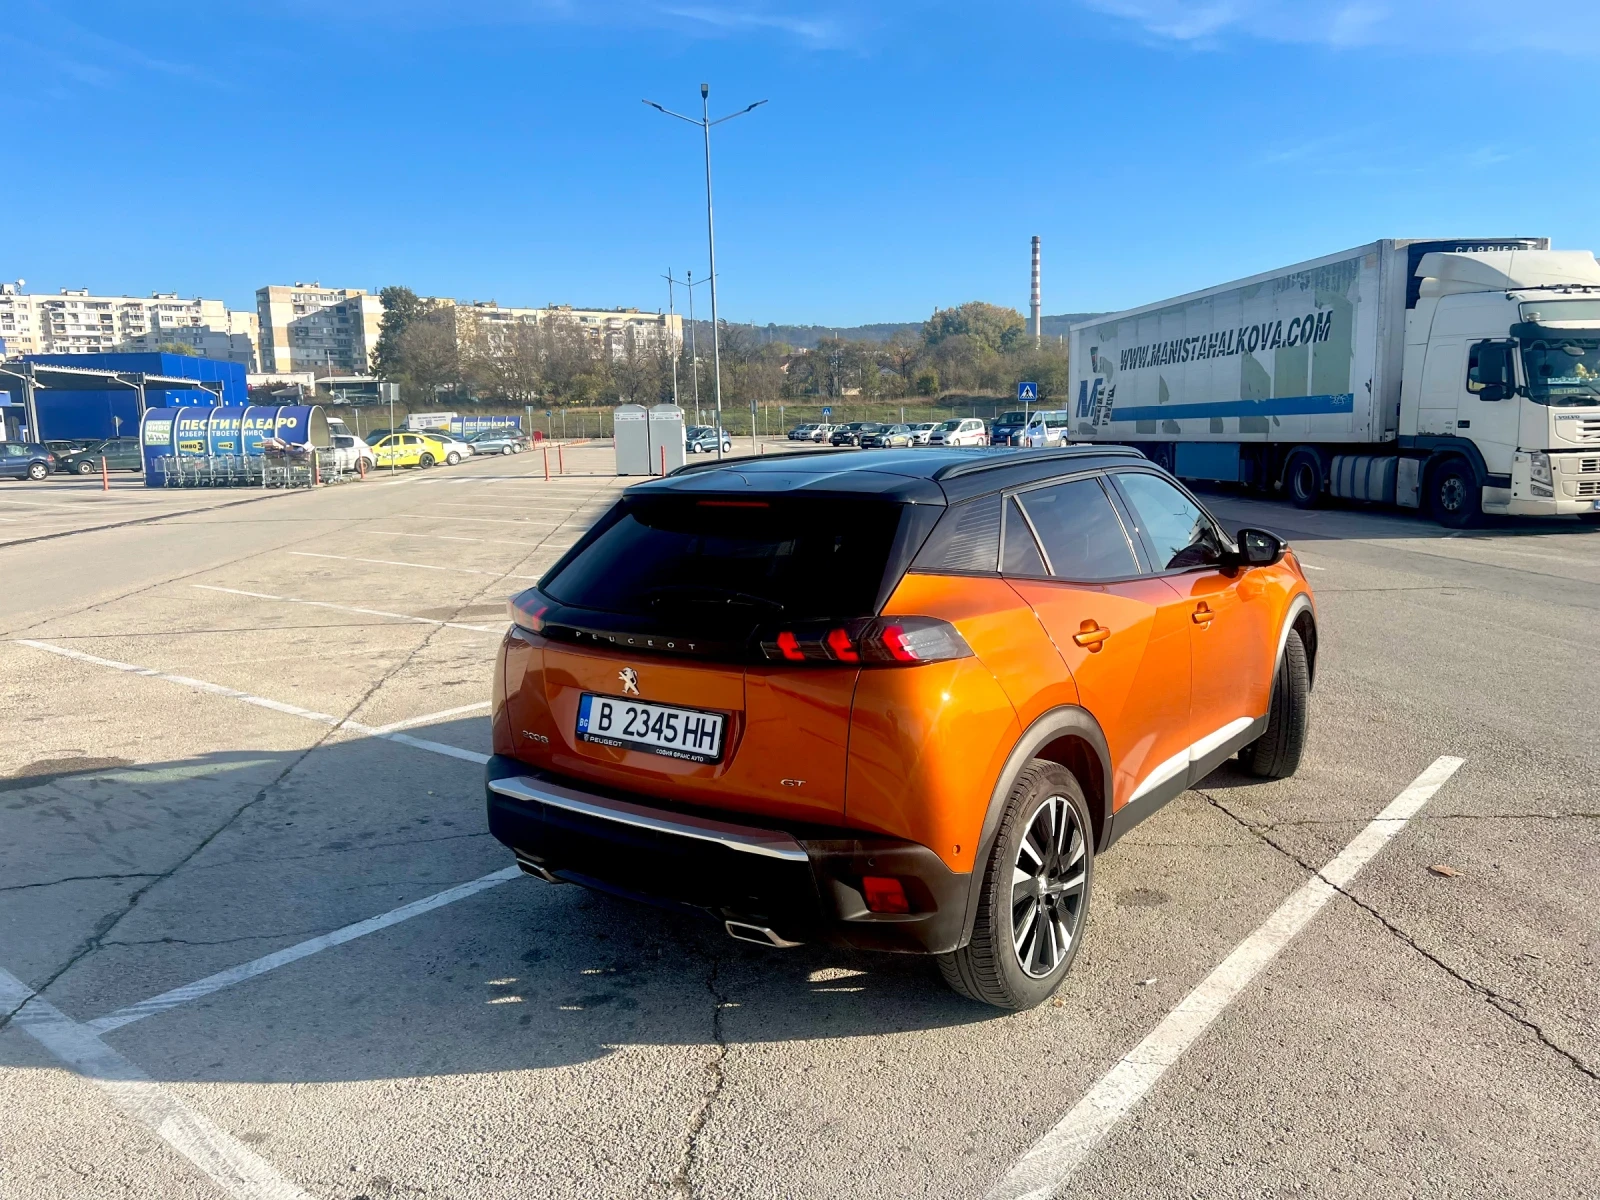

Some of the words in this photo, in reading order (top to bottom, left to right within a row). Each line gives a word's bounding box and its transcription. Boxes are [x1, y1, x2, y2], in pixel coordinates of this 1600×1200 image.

[1455, 246, 1519, 254] CARRIER
[1119, 310, 1333, 371] WWW.MANISTAHALKOVA.COM
[197, 441, 204, 451] 3
[575, 631, 696, 651] PEUGEOT
[579, 718, 589, 728] BG
[598, 702, 613, 732] B
[622, 707, 679, 743] 2345
[681, 716, 717, 751] HH
[590, 736, 623, 747] PEUGEOT
[655, 748, 673, 758] СОФИЯ
[691, 754, 704, 762] АУТО
[780, 779, 807, 787] GT
